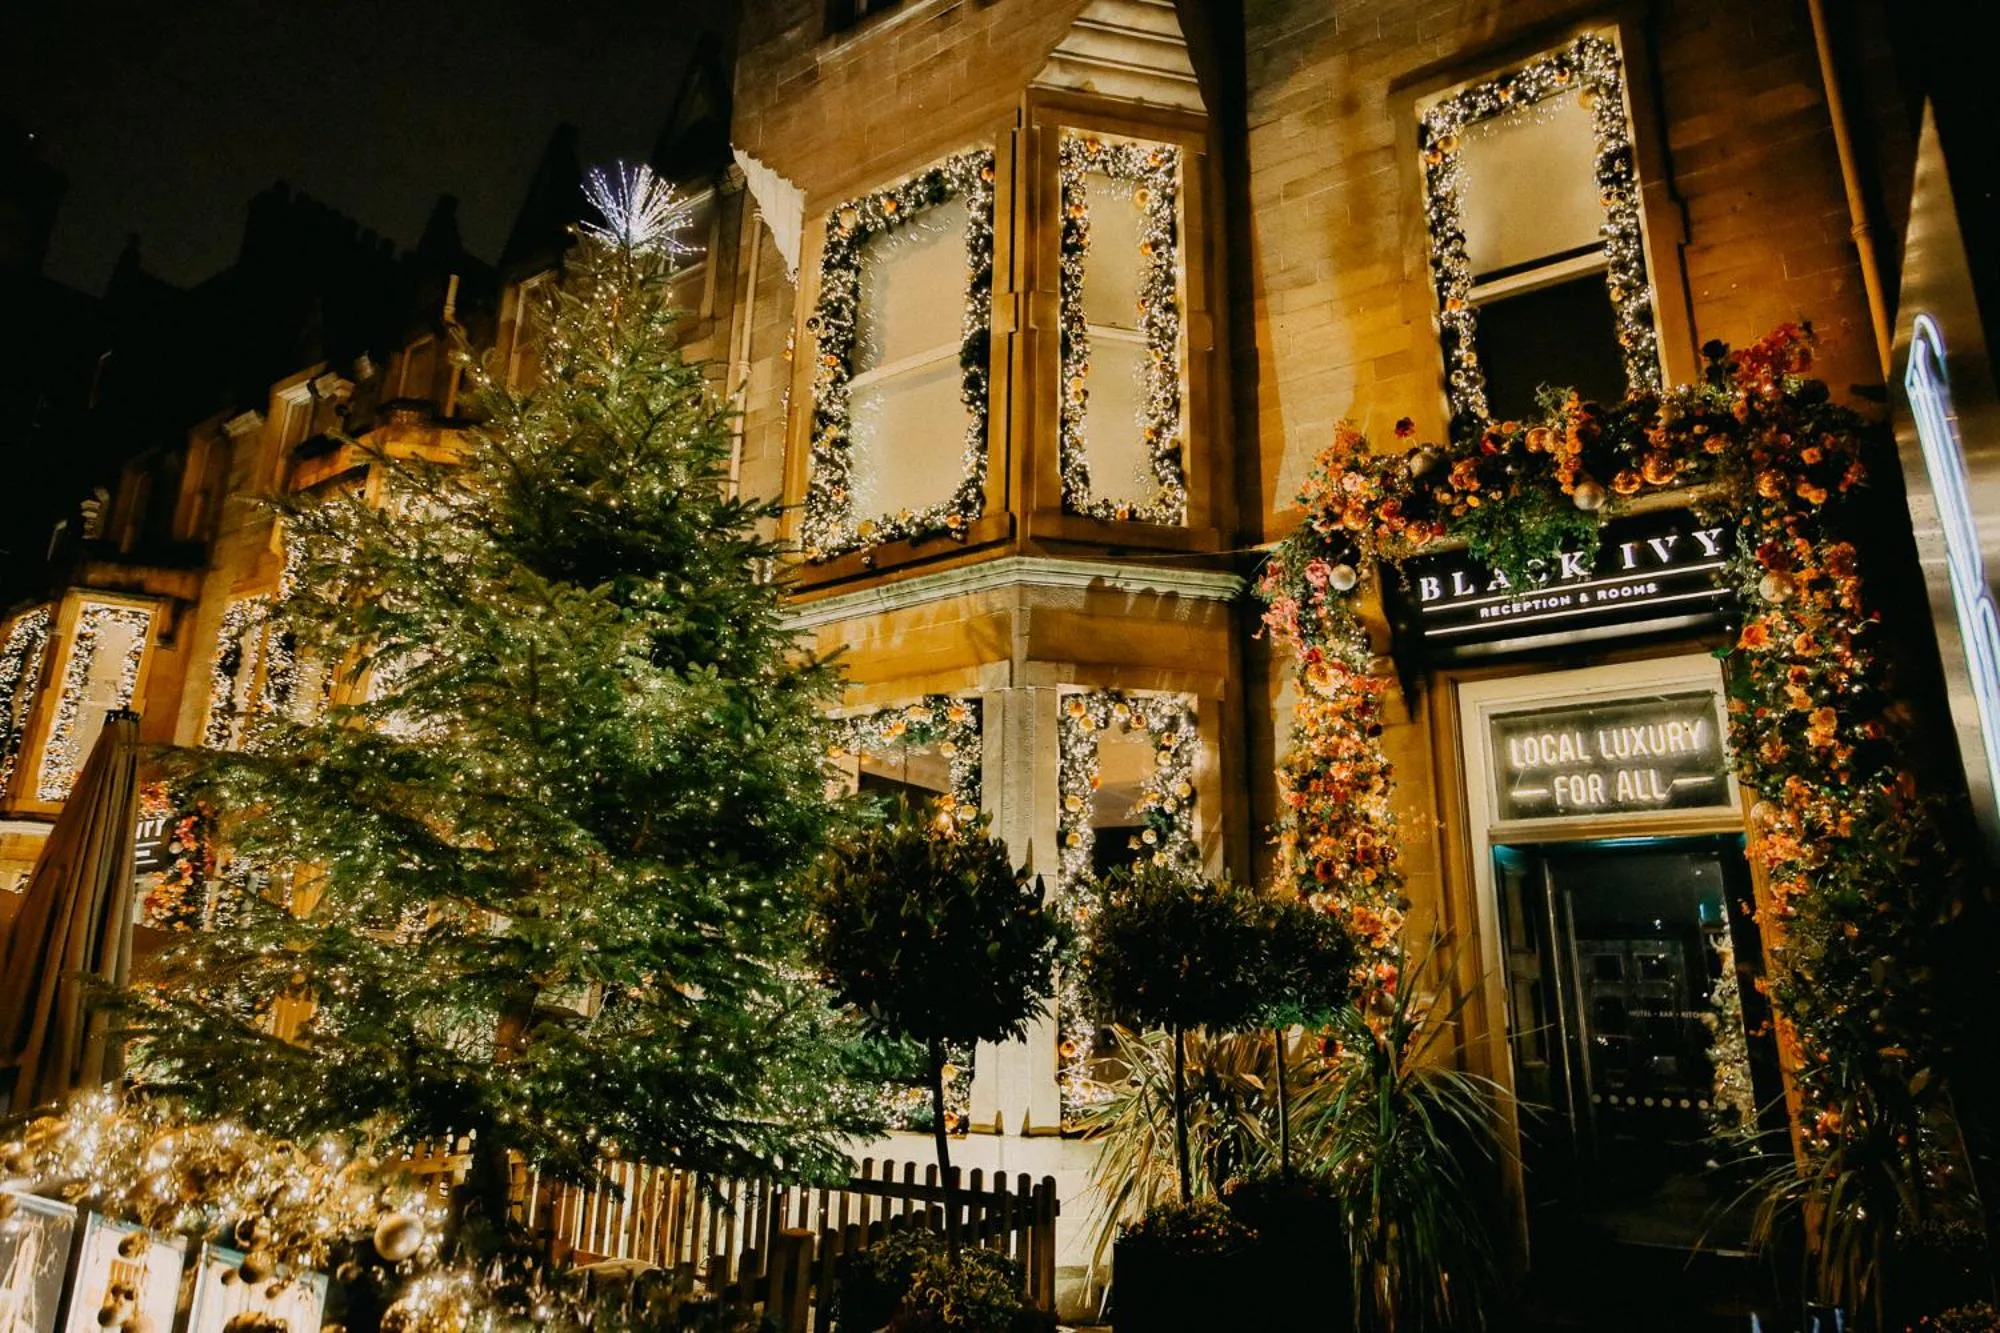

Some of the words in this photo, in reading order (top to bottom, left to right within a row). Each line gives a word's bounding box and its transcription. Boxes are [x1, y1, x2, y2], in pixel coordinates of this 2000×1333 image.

[1420, 551, 1593, 602] BLACK
[1619, 528, 1724, 570] IVY
[1480, 596, 1571, 618] RECEPTION
[1580, 592, 1590, 603] &
[1597, 582, 1658, 601] ROOMS
[1510, 731, 1592, 769] LOCAL
[1600, 720, 1702, 760] LUXURY
[1553, 773, 1606, 806] FOR
[1617, 768, 1667, 802] ALL
